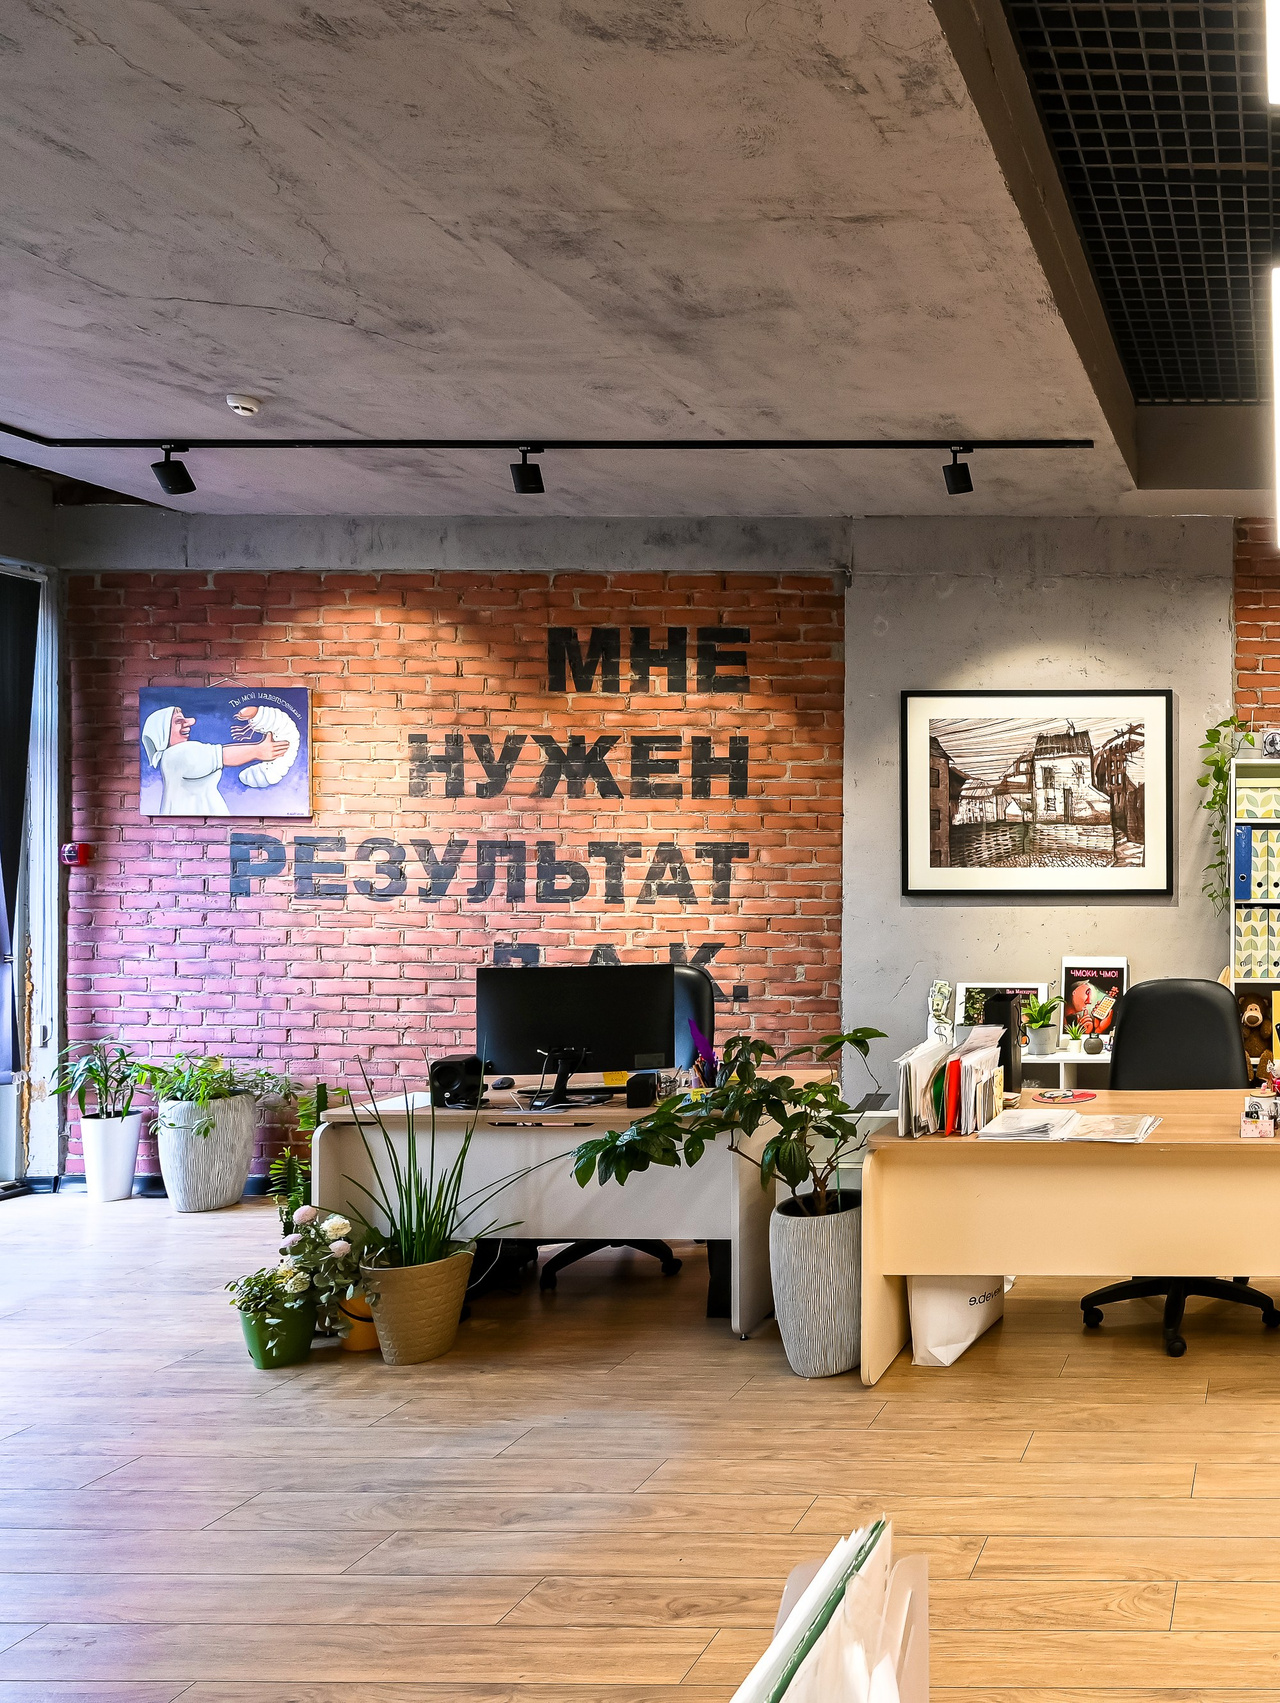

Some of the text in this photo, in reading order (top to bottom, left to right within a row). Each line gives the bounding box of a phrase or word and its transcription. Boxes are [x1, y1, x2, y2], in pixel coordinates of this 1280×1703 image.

[547, 627, 750, 693] МНЕ
[407, 734, 749, 799] НУЖЕН
[229, 832, 750, 905] РЕЗУЛЬТАТ
[1070, 969, 1119, 978] ЧМОКИ, ЧМО!
